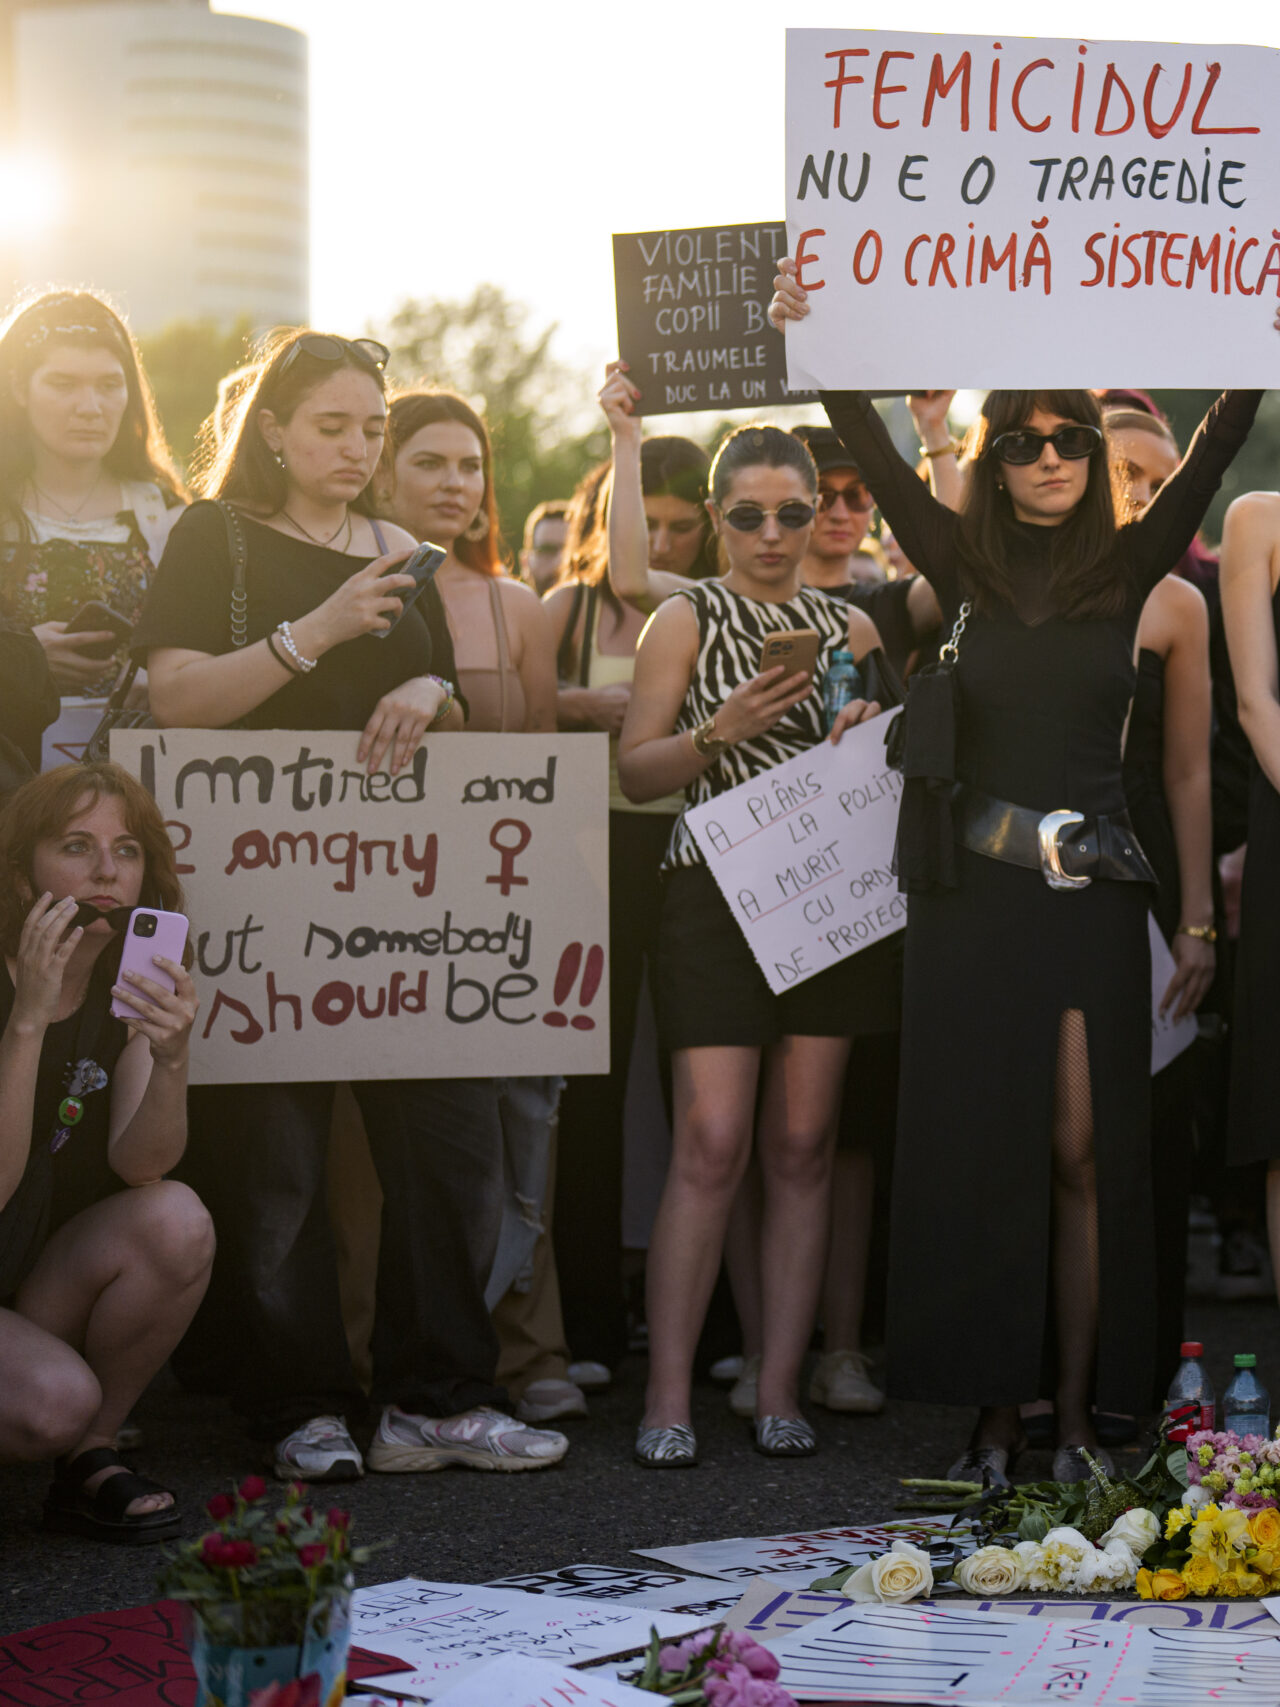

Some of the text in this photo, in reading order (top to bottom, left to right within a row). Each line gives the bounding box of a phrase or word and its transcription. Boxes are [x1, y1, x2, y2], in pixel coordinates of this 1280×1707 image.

[824, 42, 1260, 139] FEMICIDUL
[796, 146, 1247, 209] NU E O TRAGEDIE
[794, 228, 826, 292] E
[852, 230, 882, 287] O
[904, 216, 1052, 295] CRIMĂ
[643, 263, 757, 304] FAMILIE
[656, 301, 720, 336] COPII
[648, 345, 766, 374] TRAUMELE
[665, 384, 697, 405] DUC
[709, 382, 730, 400] LA
[742, 380, 766, 398] UN
[462, 756, 557, 804] and
[704, 772, 823, 853] A PLÂNS
[787, 812, 819, 844] LA
[225, 829, 438, 897] angry
[737, 840, 841, 920] A MURIT
[803, 894, 835, 925] CU
[197, 911, 532, 977] ut somebody
[774, 947, 813, 984] DE
[203, 971, 429, 1045] should
